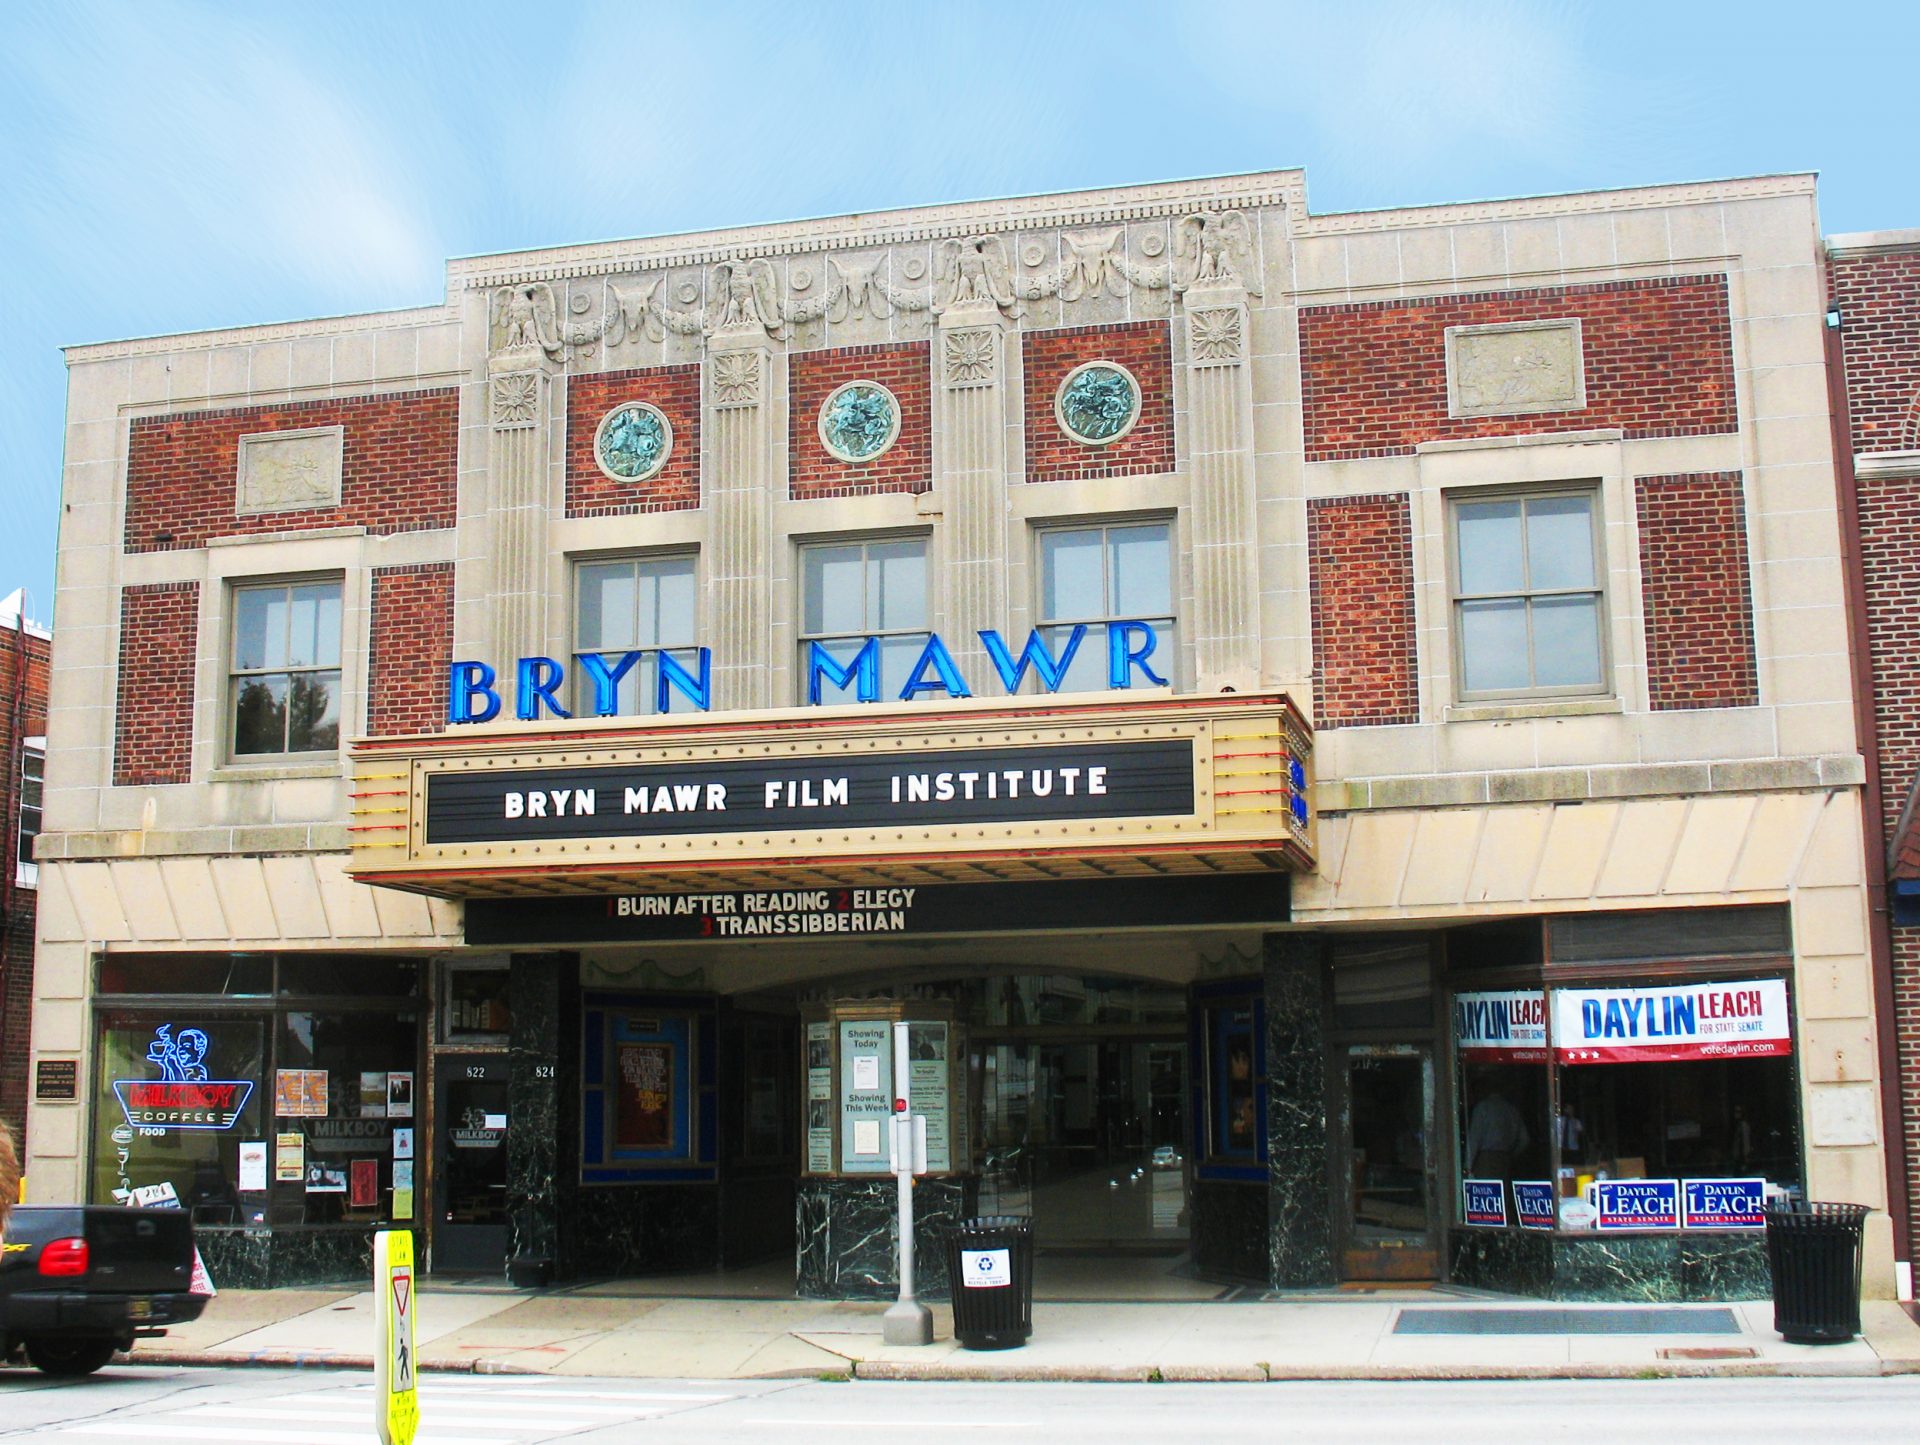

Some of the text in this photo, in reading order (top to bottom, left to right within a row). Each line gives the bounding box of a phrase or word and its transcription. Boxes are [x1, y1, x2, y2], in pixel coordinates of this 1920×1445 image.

[449, 620, 1171, 725] BRYN MAWR
[504, 766, 1108, 819] BRYN MAWR FILM INSTITUTE
[617, 897, 671, 917] BURN
[673, 894, 737, 916] AFTER
[742, 889, 830, 914] READING
[836, 890, 849, 911] 2
[852, 888, 916, 910] ELEGY
[700, 911, 906, 937] 3 TRANSSIBBERIAN
[1456, 1000, 1509, 1040] DAYLIN
[1582, 990, 1762, 1039] DAYLIN LEACH
[847, 1029, 885, 1039] Showing
[1699, 1020, 1763, 1034] FOR STATE SENATE
[854, 1039, 879, 1049] Today
[1700, 1041, 1775, 1055] votedaylin.com
[466, 1066, 485, 1078] 822
[535, 1066, 554, 1078] 824
[848, 1093, 886, 1103] Showing
[845, 1103, 889, 1112] This Week
[143, 1112, 216, 1122] COFFEE
[139, 1127, 166, 1137] FOOD
[1617, 1185, 1658, 1197] DAYLIN
[1704, 1184, 1745, 1196] DAYLIN
[1466, 1192, 1503, 1214] LEACH
[1516, 1194, 1554, 1216] LEACH
[1601, 1194, 1674, 1215] LEACH
[1688, 1193, 1762, 1214] LEACH
